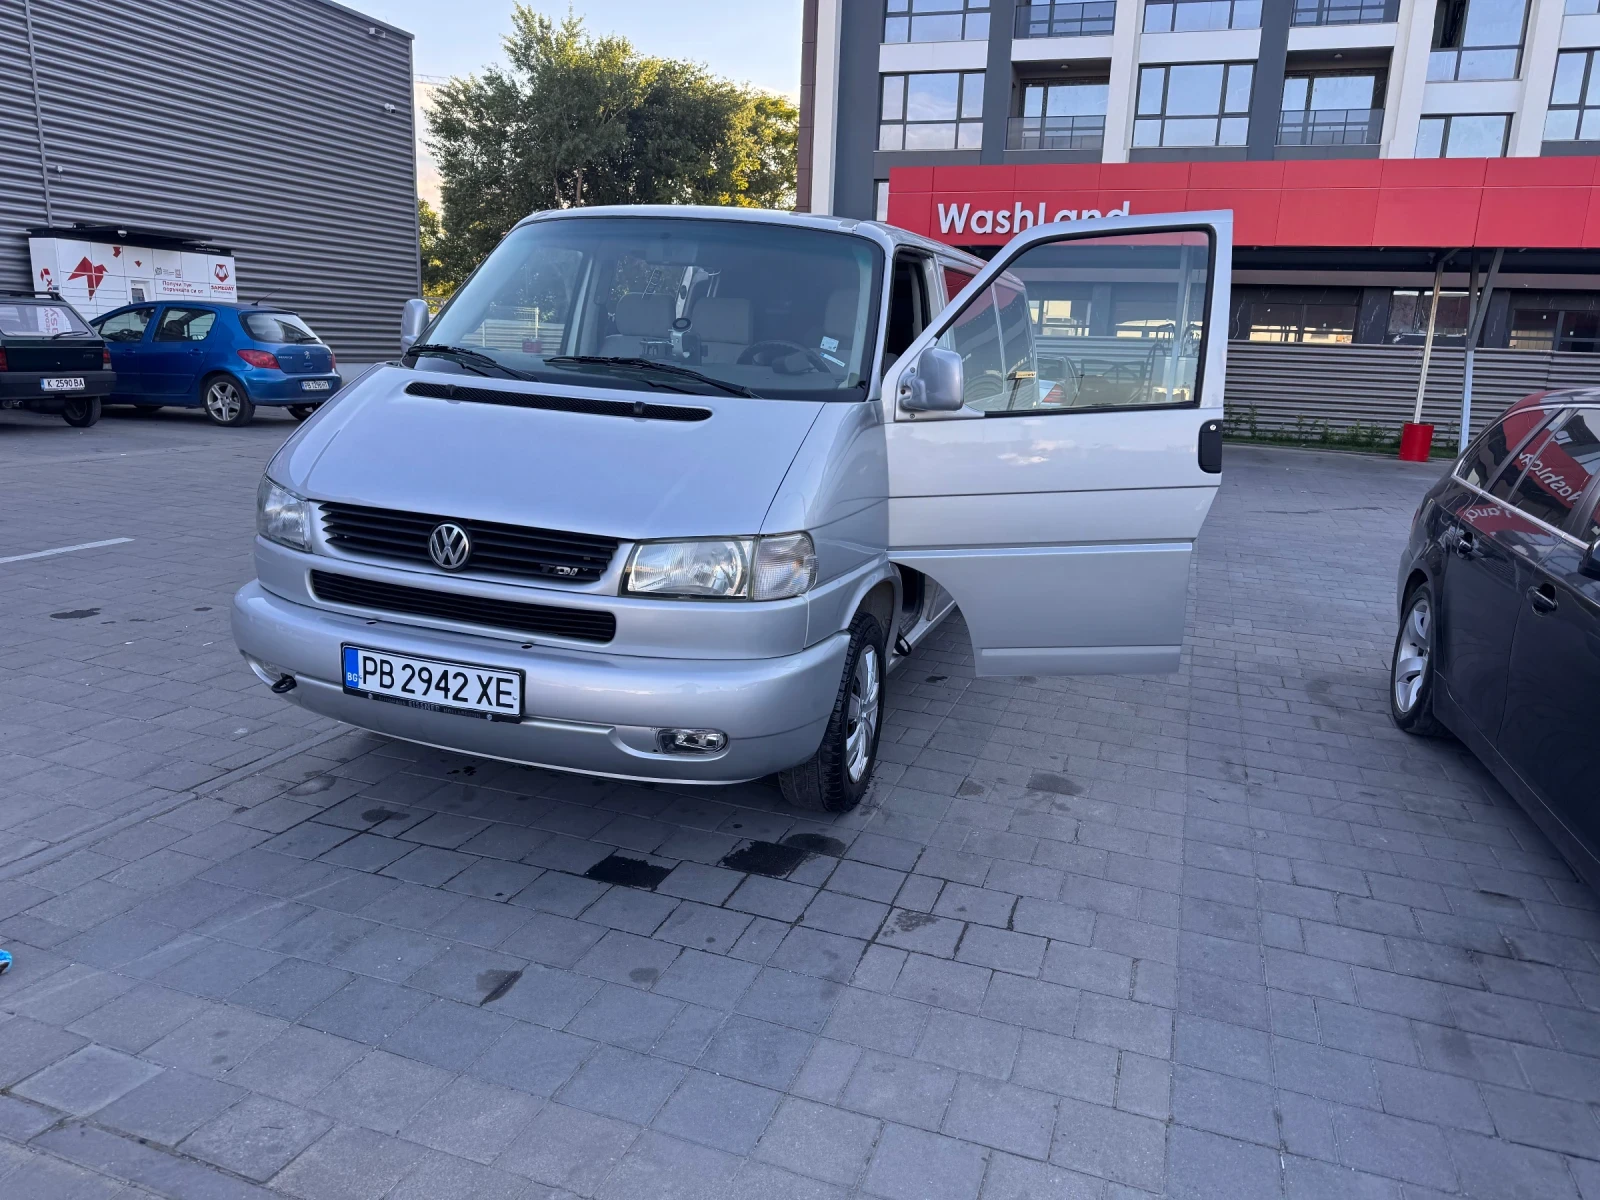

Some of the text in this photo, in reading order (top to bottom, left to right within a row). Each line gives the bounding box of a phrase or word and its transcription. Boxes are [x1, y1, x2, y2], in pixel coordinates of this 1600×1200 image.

[46, 378, 84, 388] K 2590 BA
[347, 672, 358, 682] BG
[362, 655, 514, 709] PB 2942 XE
